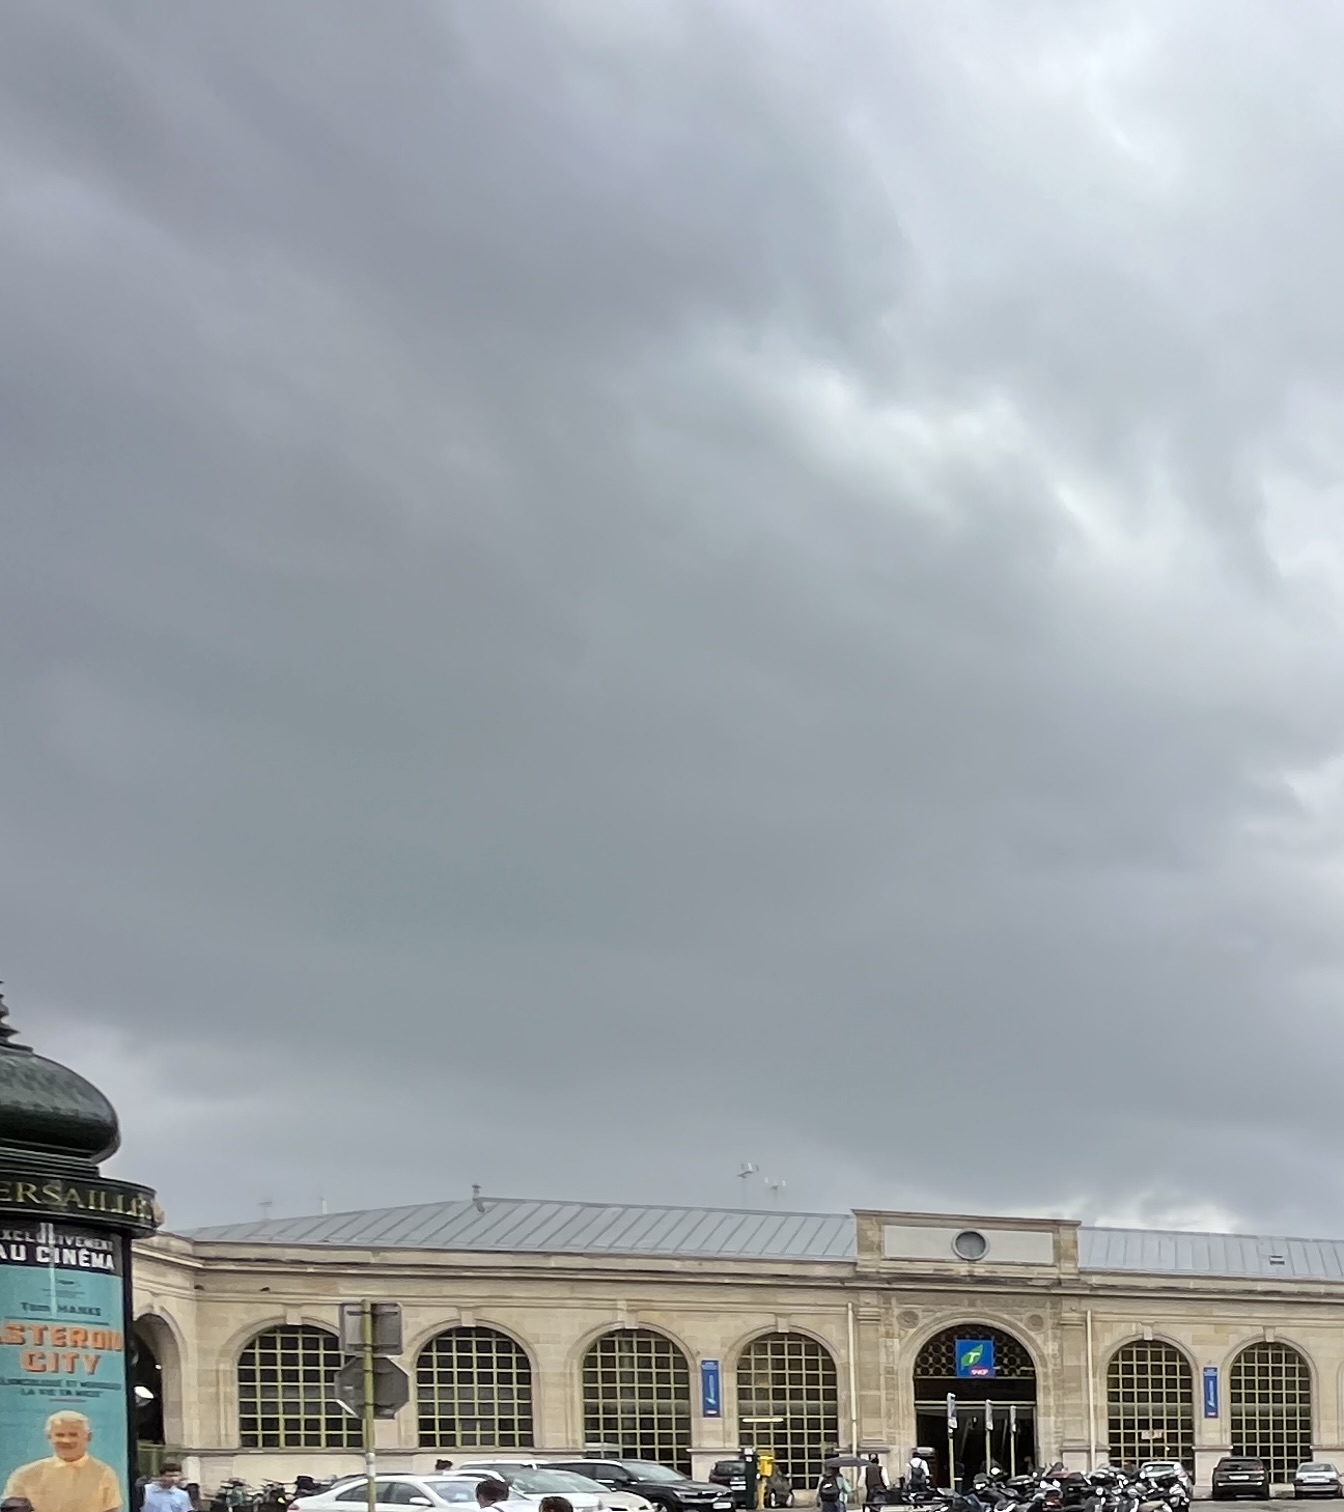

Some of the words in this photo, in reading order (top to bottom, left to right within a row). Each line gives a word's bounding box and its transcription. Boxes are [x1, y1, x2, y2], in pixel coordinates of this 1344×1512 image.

[36, 1246, 115, 1270] CINÉMA
[0, 1323, 123, 1352] STEROID
[22, 1350, 102, 1376] CITY
